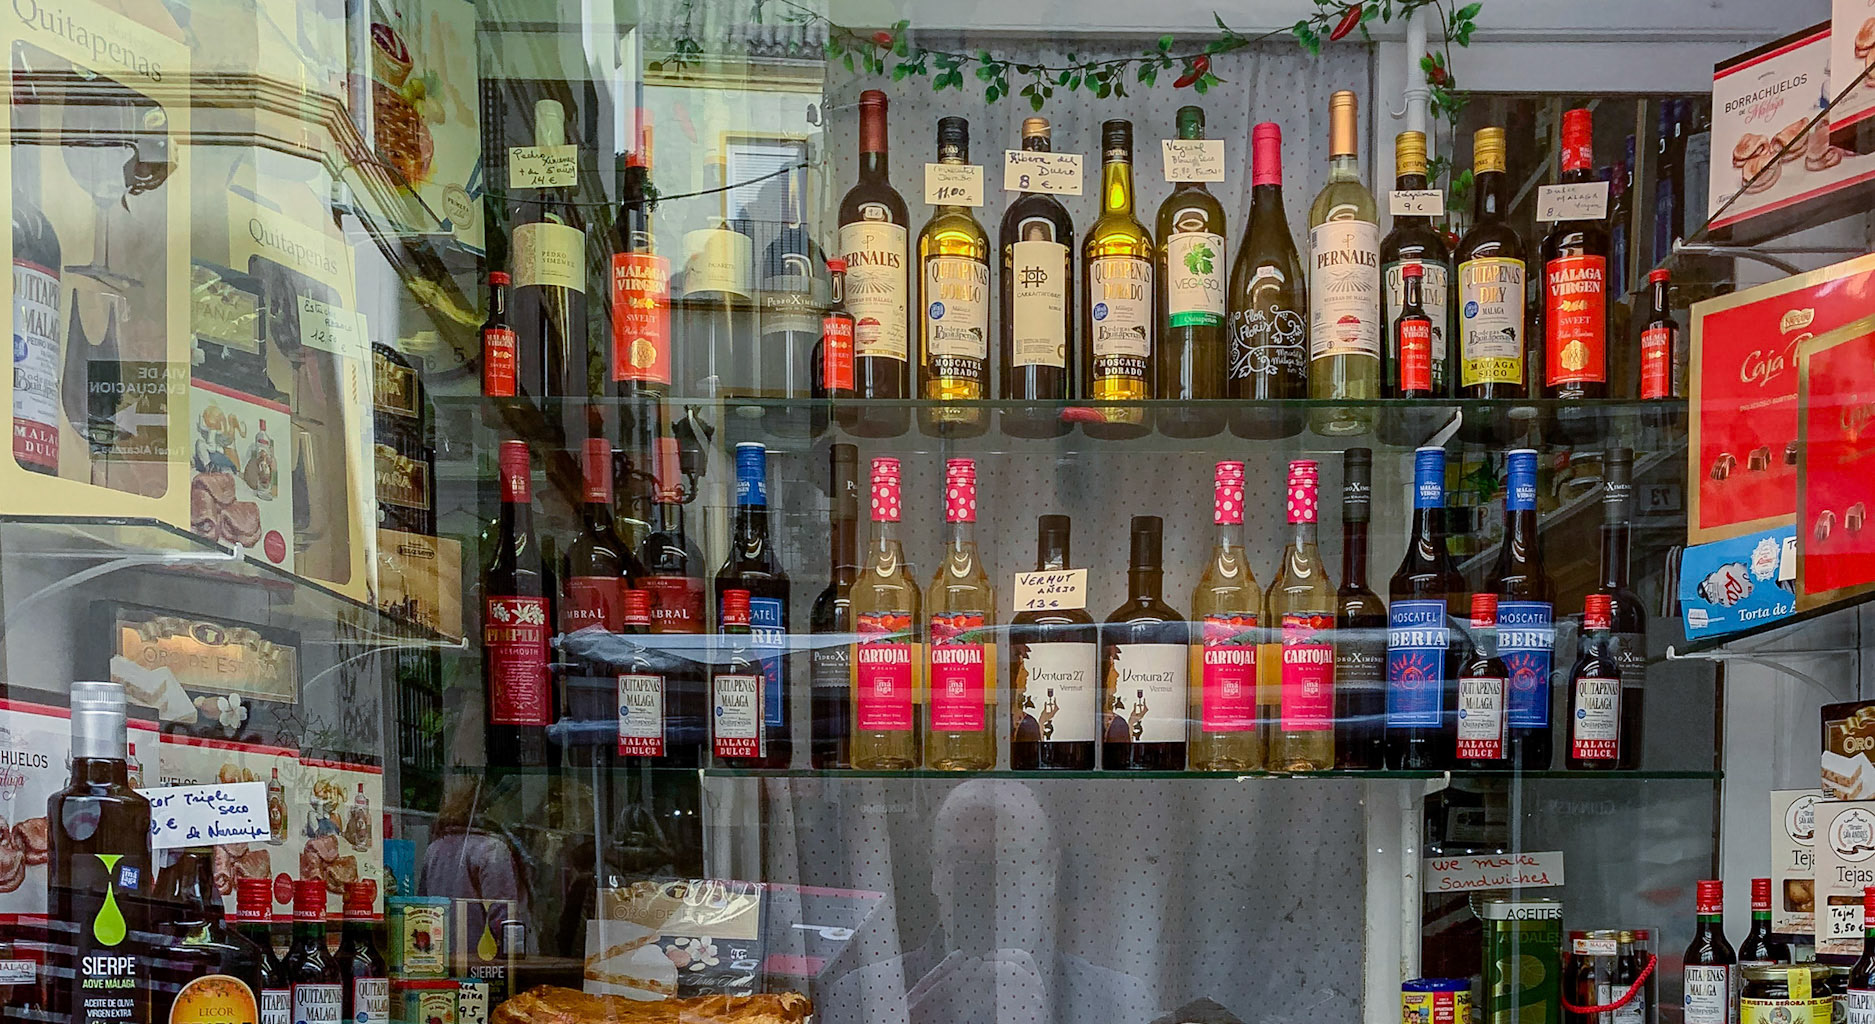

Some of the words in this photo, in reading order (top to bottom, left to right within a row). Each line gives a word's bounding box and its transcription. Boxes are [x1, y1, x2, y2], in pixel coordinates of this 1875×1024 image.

[11, 0, 163, 83] Quitapenas
[1725, 73, 1809, 113] BORRACHUELOS
[248, 217, 339, 277] Quitapenas
[1317, 248, 1378, 271] PERNALES
[1466, 262, 1521, 287] QUITAPENAS
[1549, 267, 1602, 284] MÁLAGA
[617, 279, 667, 294] VIRGEN
[1175, 277, 1222, 293] VEGASOL
[1551, 282, 1602, 297] VIRGEN
[1479, 285, 1507, 304] DRY
[1560, 315, 1592, 325] SWEET
[935, 357, 983, 371] MOSCATEL
[1099, 357, 1147, 371] MOSCATEL
[1740, 349, 1784, 386] Caja
[940, 366, 978, 379] DORADO
[1103, 366, 1143, 378] DORADO
[1020, 572, 1075, 587] VERMUT
[1391, 611, 1437, 623] MOSCATEL
[1500, 613, 1547, 624] MOSCATEL
[859, 648, 910, 664] CARTOJAL
[932, 648, 982, 664] CARTOJAL
[1205, 649, 1256, 665] CARTOJAL
[1284, 648, 1333, 664] CARTOJAL
[1032, 667, 1072, 682] Ventura
[1122, 667, 1162, 683] Ventura
[620, 679, 660, 694] QUITAPENAS
[716, 679, 756, 694] QUITAPENAS
[1460, 681, 1501, 697] QUITAPENAS
[1579, 681, 1619, 697] QUITAPENAS
[626, 694, 655, 708] MALAGA
[721, 694, 749, 708] MALAGA
[1465, 697, 1493, 710] MALAGA
[1584, 697, 1613, 710] MALAGA
[620, 738, 661, 747] MALAGA
[716, 738, 757, 748] MALAGA
[1457, 740, 1499, 750] MALAGA
[1574, 740, 1616, 750] MALAGA
[1843, 736, 1875, 755] ORO
[625, 746, 657, 756] DULCE
[720, 747, 751, 757] DULCE
[1461, 748, 1494, 758] DULCE
[1580, 748, 1612, 758] DULCE
[184, 790, 236, 810] Triple
[218, 804, 249, 815] seco
[166, 818, 178, 830] €
[1432, 858, 1463, 871] we
[1472, 855, 1540, 869] make
[1836, 865, 1874, 889] Tejas
[1506, 907, 1563, 920] ACEITES
[82, 956, 136, 976] SIERPE
[470, 965, 504, 979] SIERPE
[82, 979, 104, 989] AOVE
[105, 978, 135, 989] MÁLAGA
[84, 999, 107, 1008] ACEITE
[108, 999, 116, 1008] DE
[111, 1008, 132, 1018] EXTRA
[199, 1006, 235, 1017] LICOR
[305, 1006, 338, 1022] MALAGA
